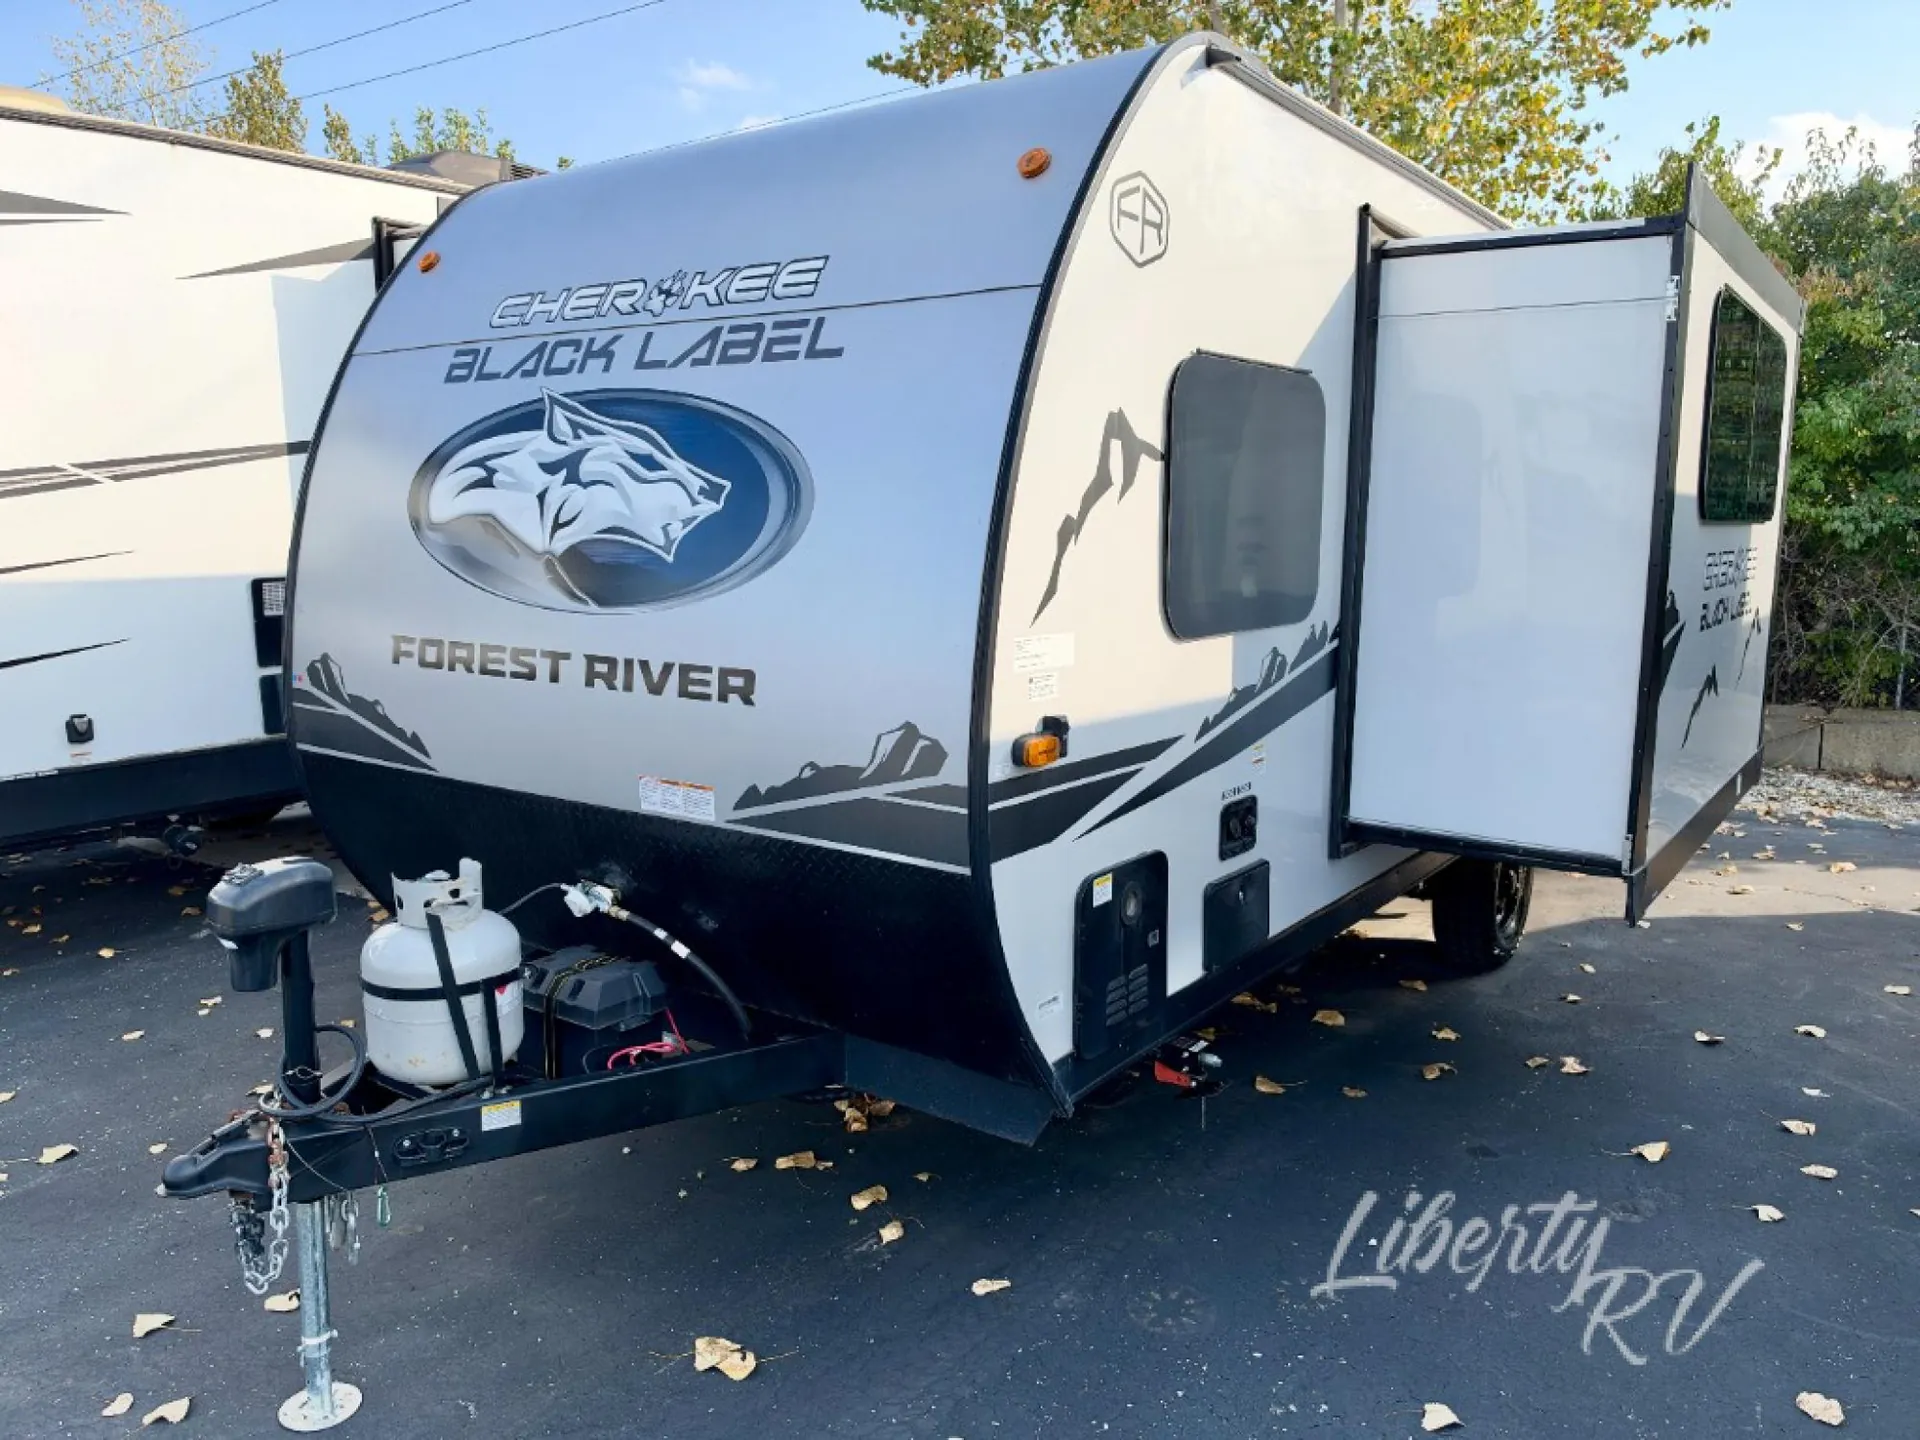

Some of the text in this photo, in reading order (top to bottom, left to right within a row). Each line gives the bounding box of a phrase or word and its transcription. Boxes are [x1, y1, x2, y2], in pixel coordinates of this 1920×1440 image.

[444, 316, 844, 383] BLACK LABEL
[391, 634, 757, 707] FOREST RIVER
